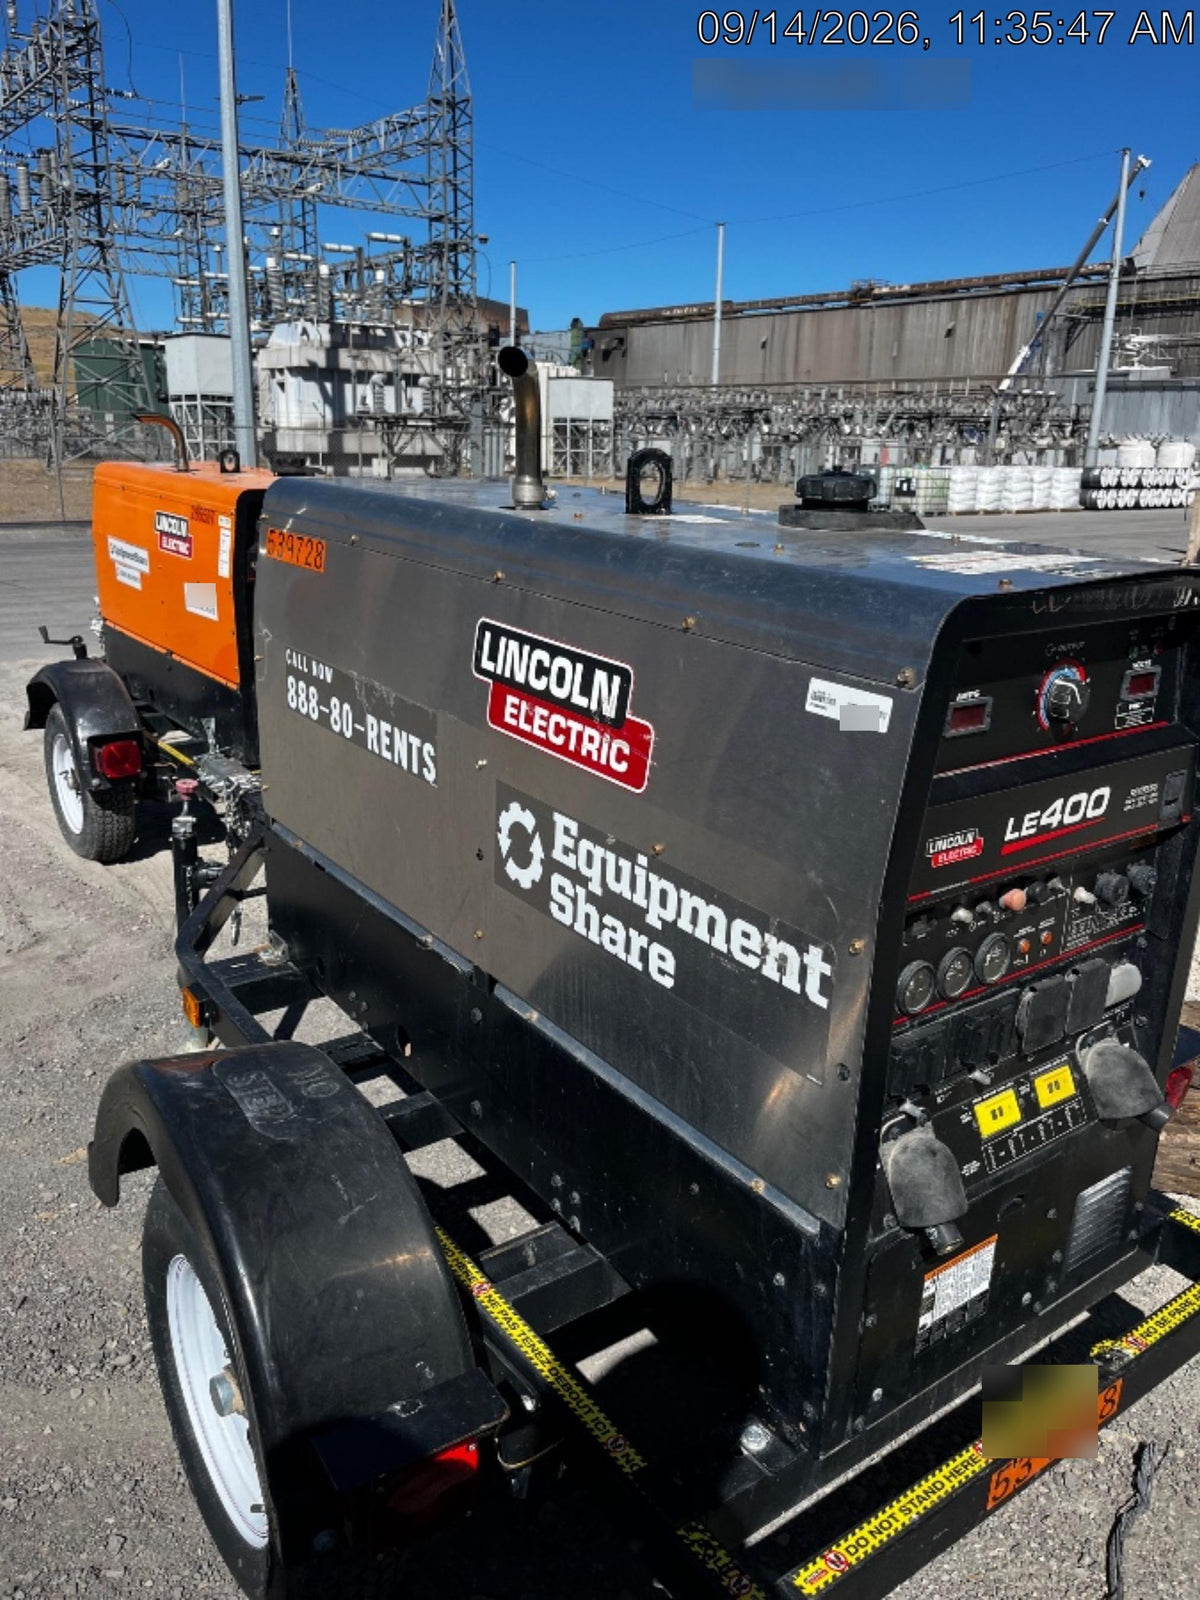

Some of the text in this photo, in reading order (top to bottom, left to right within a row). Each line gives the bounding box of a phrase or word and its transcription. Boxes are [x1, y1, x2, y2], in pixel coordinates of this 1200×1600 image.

[155, 514, 188, 538] LINCOLN
[267, 529, 325, 570] 539728
[285, 648, 335, 684] CALL NOW
[481, 630, 622, 719] LINCOLN
[286, 674, 437, 785] 888-80-RENTS
[929, 831, 976, 854] LINCOLN
[1003, 786, 1111, 842] LE400
[550, 872, 676, 989] Share
[551, 811, 832, 1010] Equipment
[498, 1309, 520, 1331] PAS
[517, 1329, 552, 1368] TENEZ
[547, 1366, 595, 1416] DEBOUT
[845, 1454, 981, 1557] DO NOT STAND HERE
